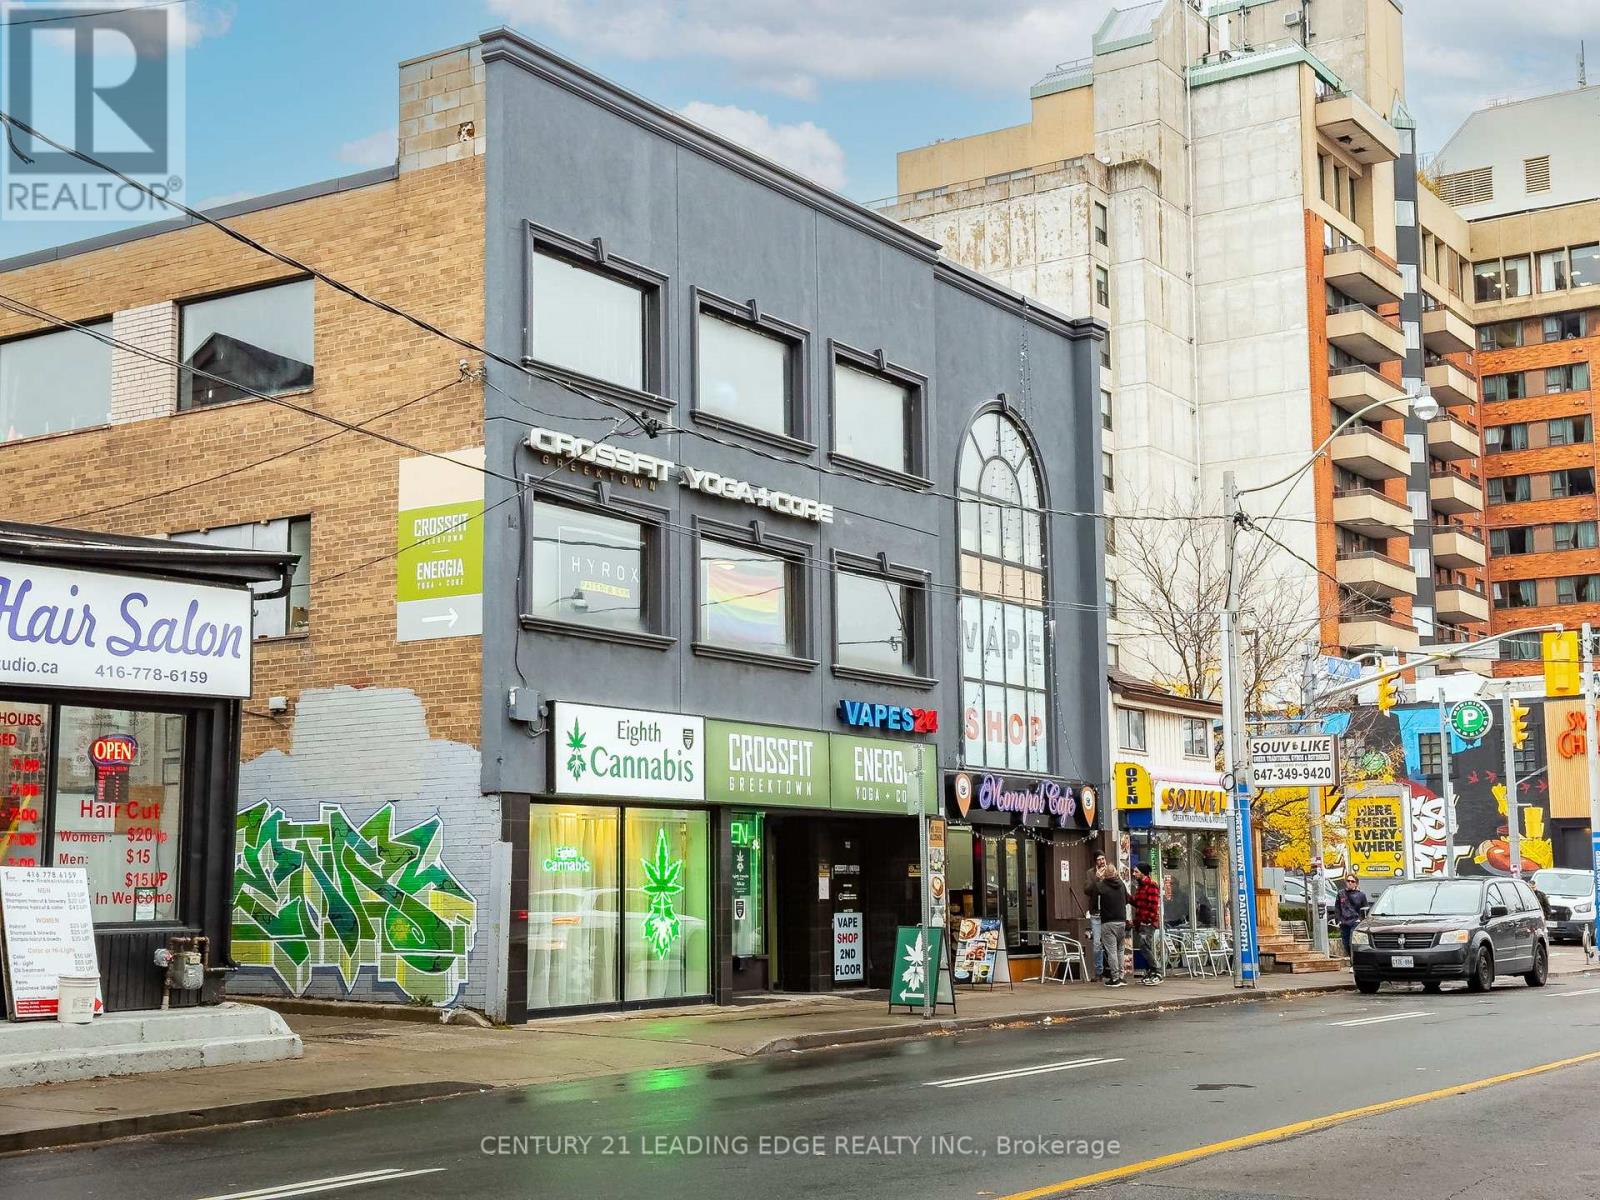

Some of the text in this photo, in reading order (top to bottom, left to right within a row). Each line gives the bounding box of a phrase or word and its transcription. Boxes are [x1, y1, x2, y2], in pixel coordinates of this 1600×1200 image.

[530, 427, 674, 482] CROSSFIT
[542, 455, 657, 491] GREEKTOWN
[414, 512, 468, 537] CROSSFIT
[416, 557, 464, 580] ENERGIA
[571, 556, 639, 584] HYROX
[0, 576, 243, 659] Hair Salon
[963, 620, 1042, 666] VAPE
[95, 665, 208, 684] 416-778-6159
[617, 719, 662, 747] Eighth
[964, 707, 1043, 746] SHOP
[94, 741, 131, 760] OPEN
[728, 733, 813, 777] CROSSFIT
[590, 746, 694, 783] Cannabis
[1253, 766, 1331, 781] 647-349-9420
[729, 776, 812, 796] GREEKTOWN
[855, 786, 880, 801] YOGA
[1125, 767, 1138, 805] OPEN
[80, 799, 160, 819] Hair Cut
[127, 827, 153, 842] $20
[1353, 841, 1404, 853] WHERE
[59, 853, 89, 865] Men:
[96, 892, 108, 904] In
[112, 891, 173, 905] Welcome
[838, 917, 858, 928] VAPE
[1238, 893, 1248, 952] DANFORTH
[837, 932, 859, 944] SHOP
[840, 948, 856, 960] 2ND
[835, 963, 861, 976] FLOOR
